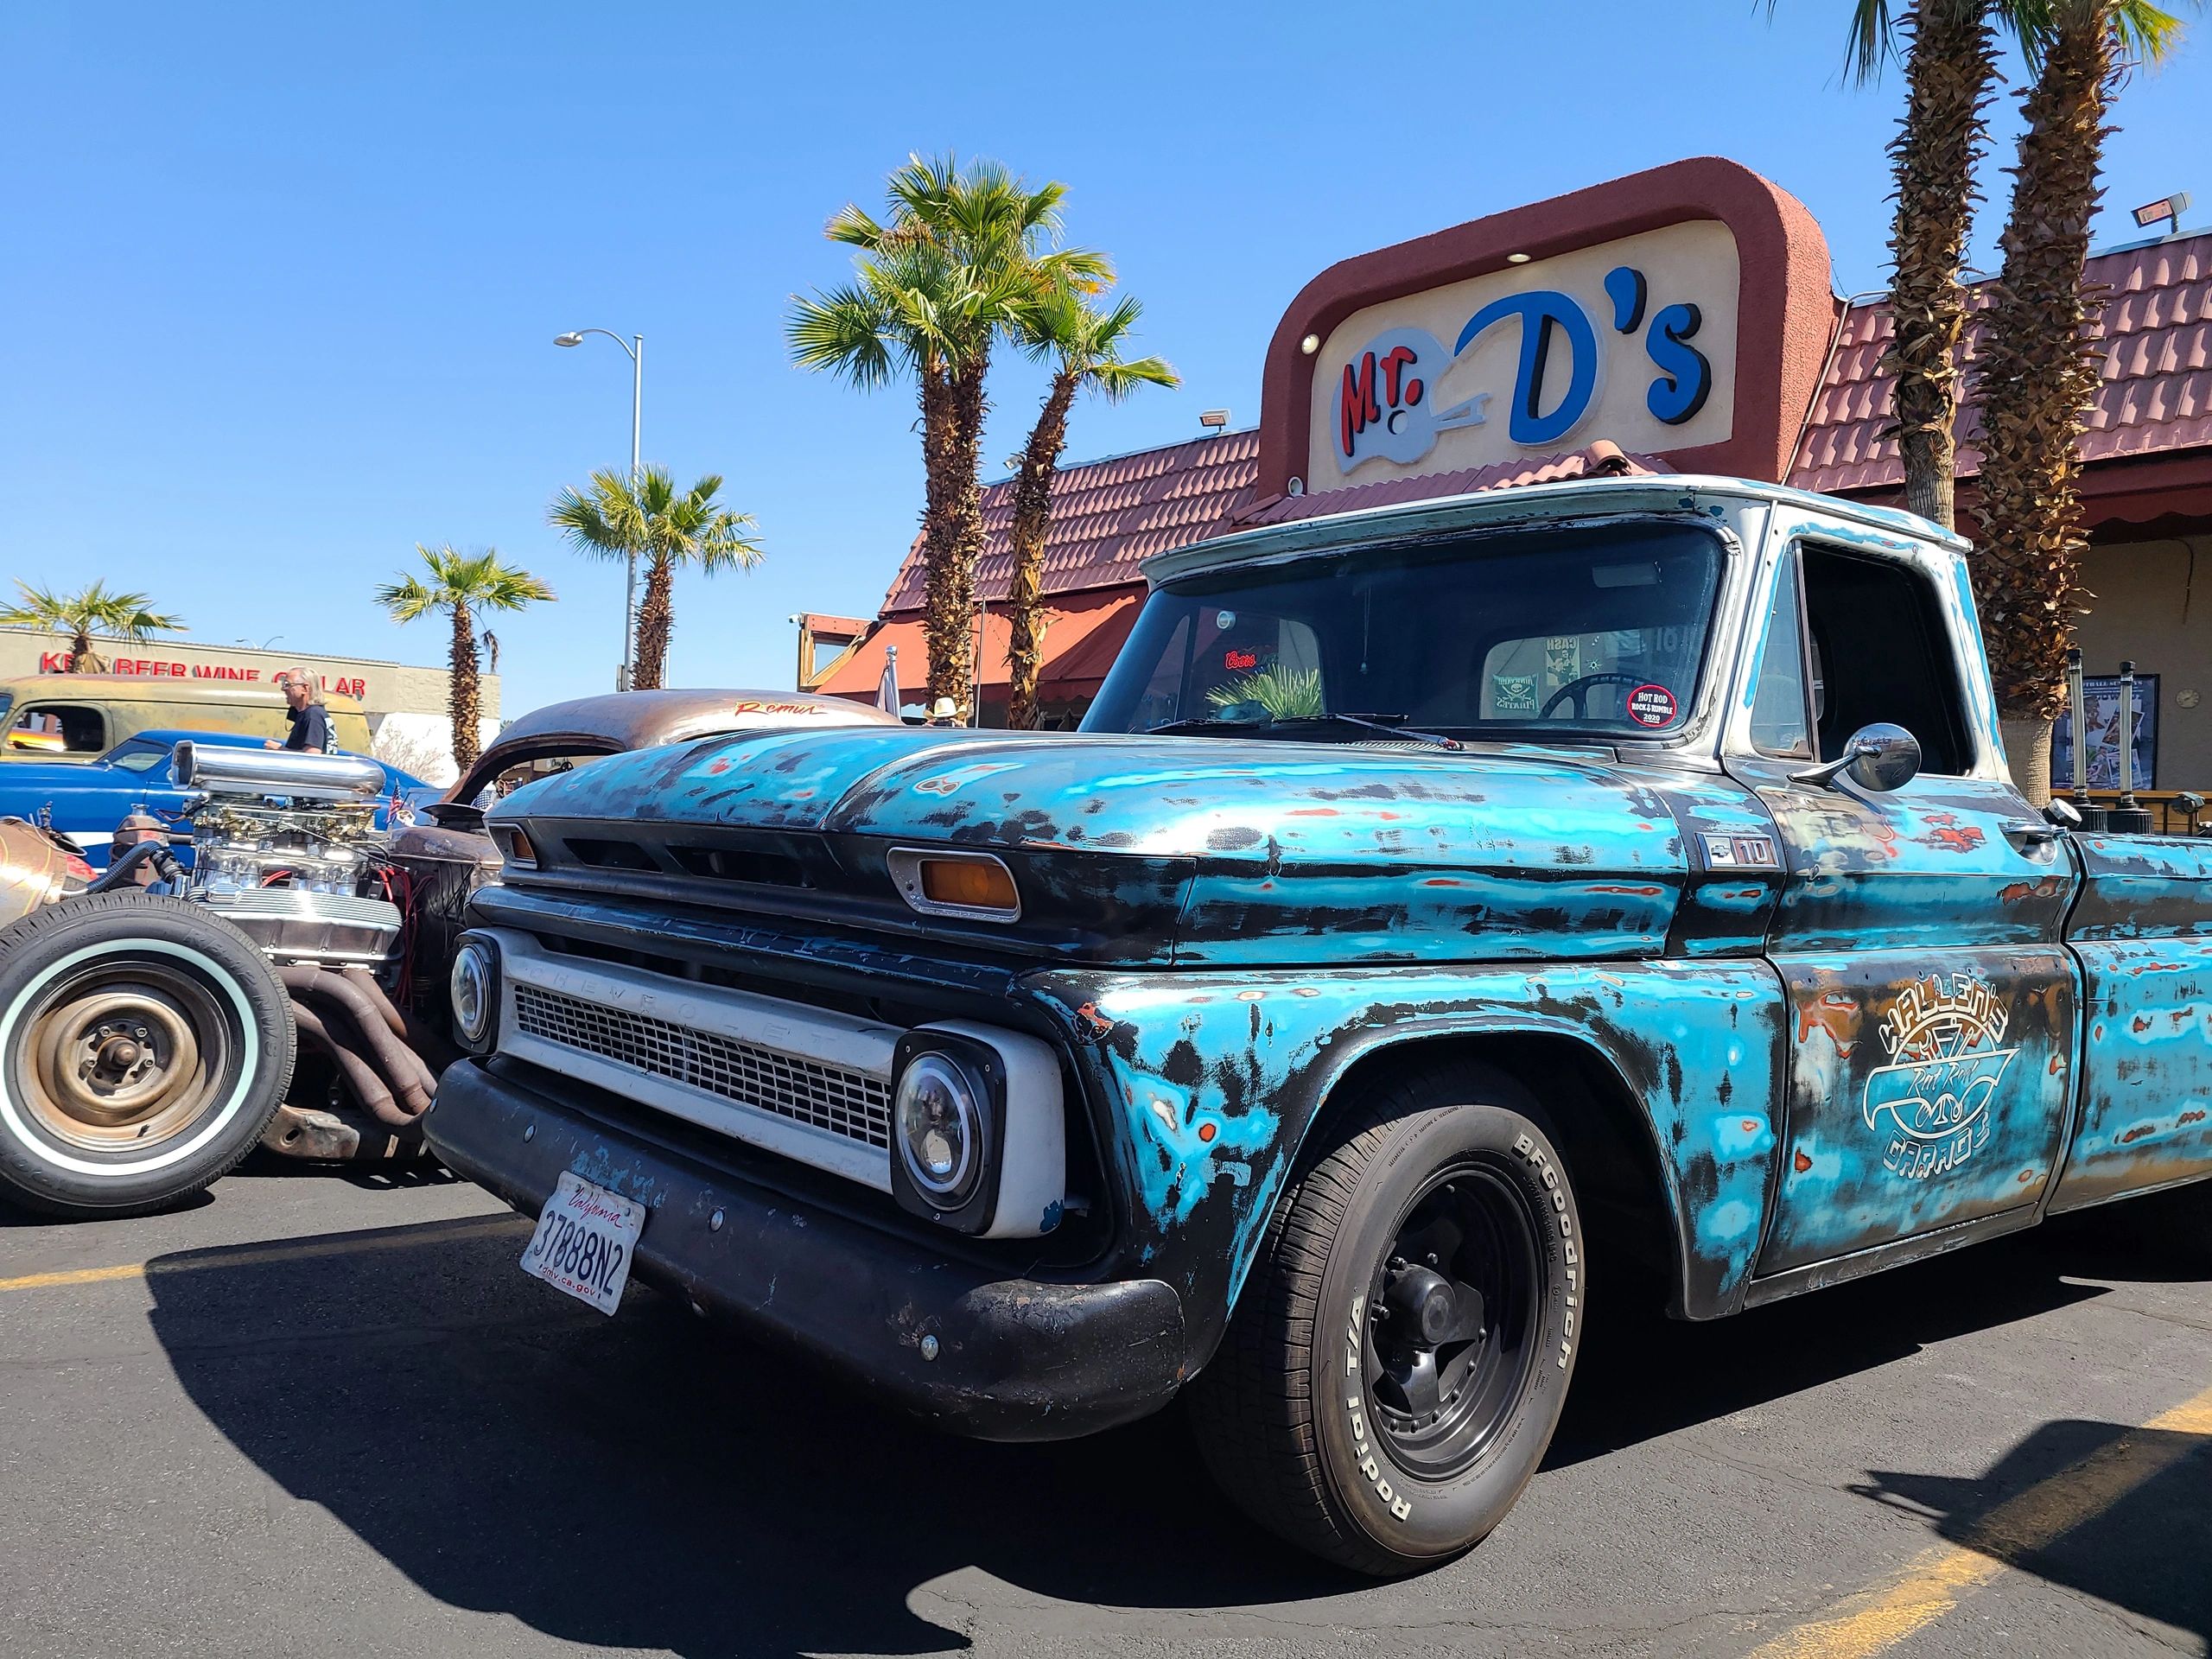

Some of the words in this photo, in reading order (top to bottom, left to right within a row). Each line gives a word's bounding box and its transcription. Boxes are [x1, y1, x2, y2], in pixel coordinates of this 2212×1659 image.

[1340, 346, 1424, 457] Mr.
[1454, 265, 1711, 446] D's
[117, 658, 187, 677] BEER
[194, 664, 260, 683] WINE
[1225, 650, 1256, 670] Coors
[734, 702, 828, 717] Remus
[1631, 702, 1646, 711] ROCK
[1651, 704, 1674, 715] RUMBLE
[1638, 692, 1652, 702] HOT
[1654, 694, 1668, 704] ROD
[1739, 840, 1769, 864] 10
[1906, 1065, 1943, 1097] Rat
[1883, 1110, 1991, 1179] GARAGE
[568, 1187, 623, 1229] California
[533, 1210, 624, 1296] 37888N2
[1512, 1133, 1579, 1370] BFGoodrich
[543, 1265, 596, 1296] dmv.ca.gov
[1345, 1294, 1365, 1377] T/A
[1346, 1395, 1413, 1523] Radial
